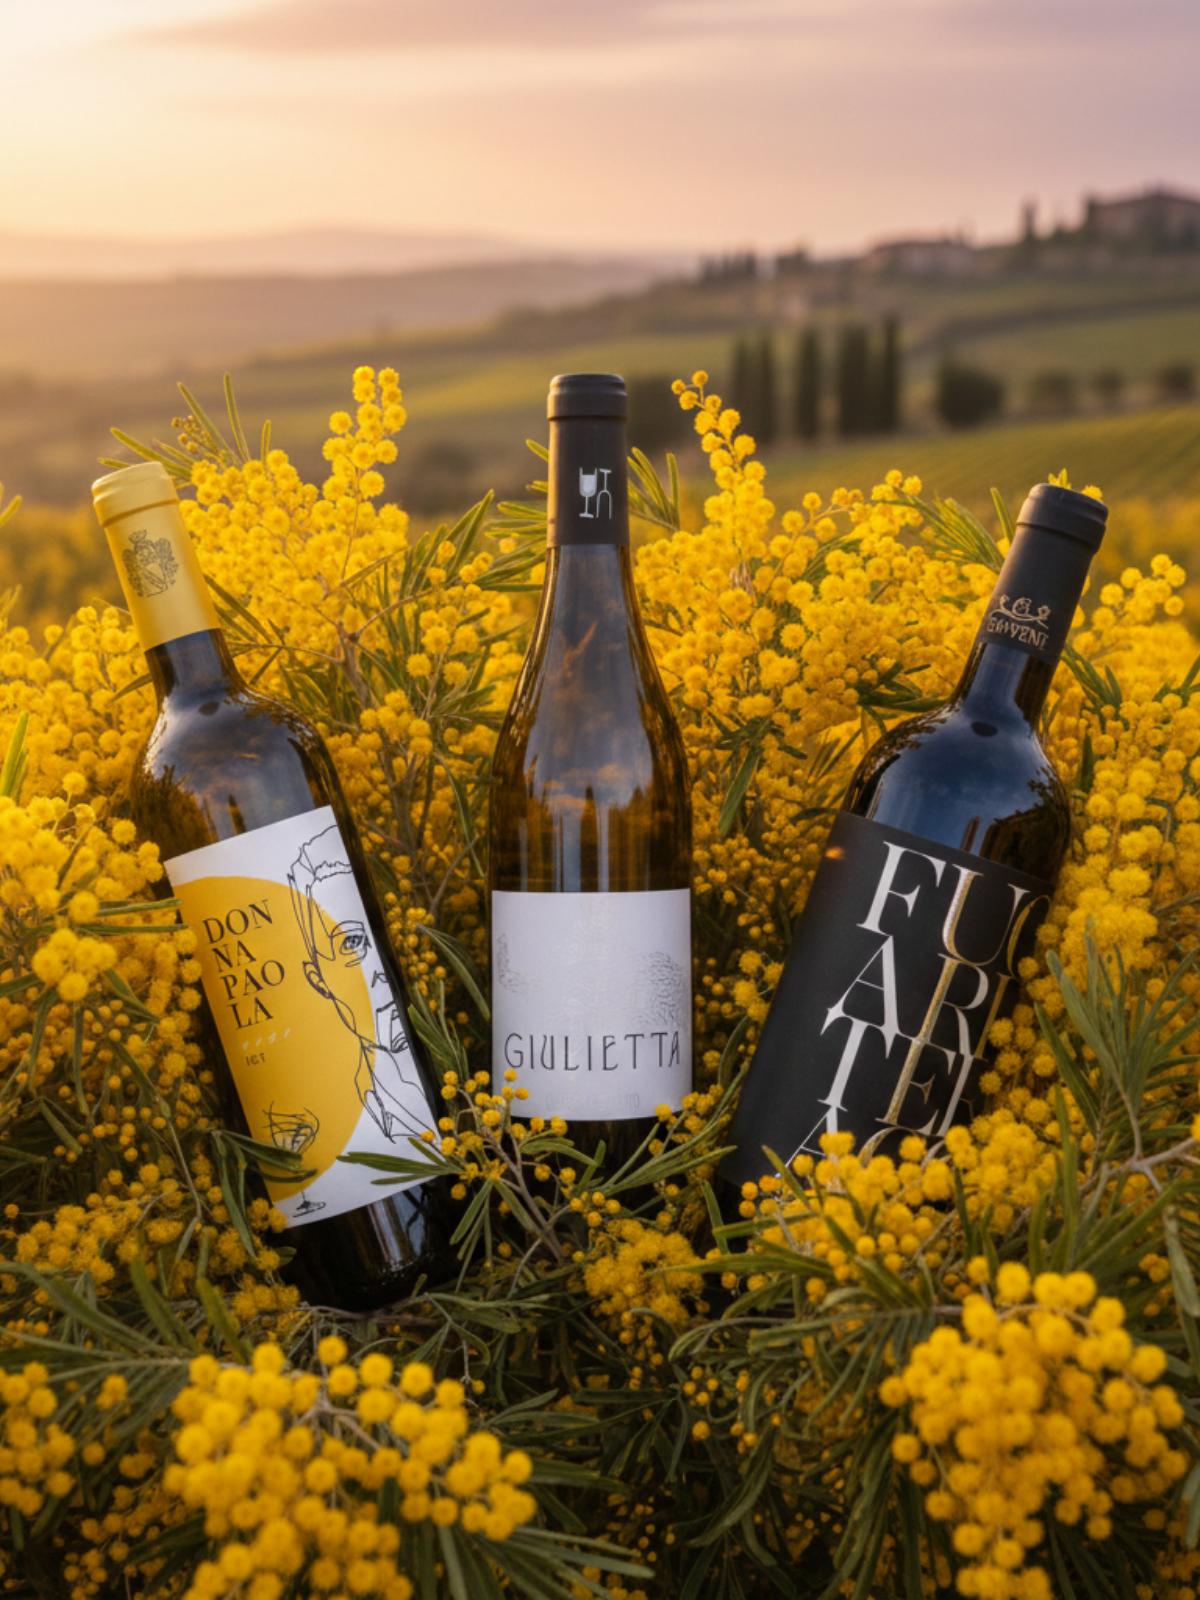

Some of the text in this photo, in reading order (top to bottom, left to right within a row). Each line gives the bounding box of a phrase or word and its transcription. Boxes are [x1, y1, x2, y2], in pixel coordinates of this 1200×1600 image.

[203, 899, 272, 944] DON
[212, 940, 257, 973] NA
[220, 960, 285, 1001] PAO
[229, 997, 274, 1031] LA
[504, 1031, 681, 1071] GIULIETTA
